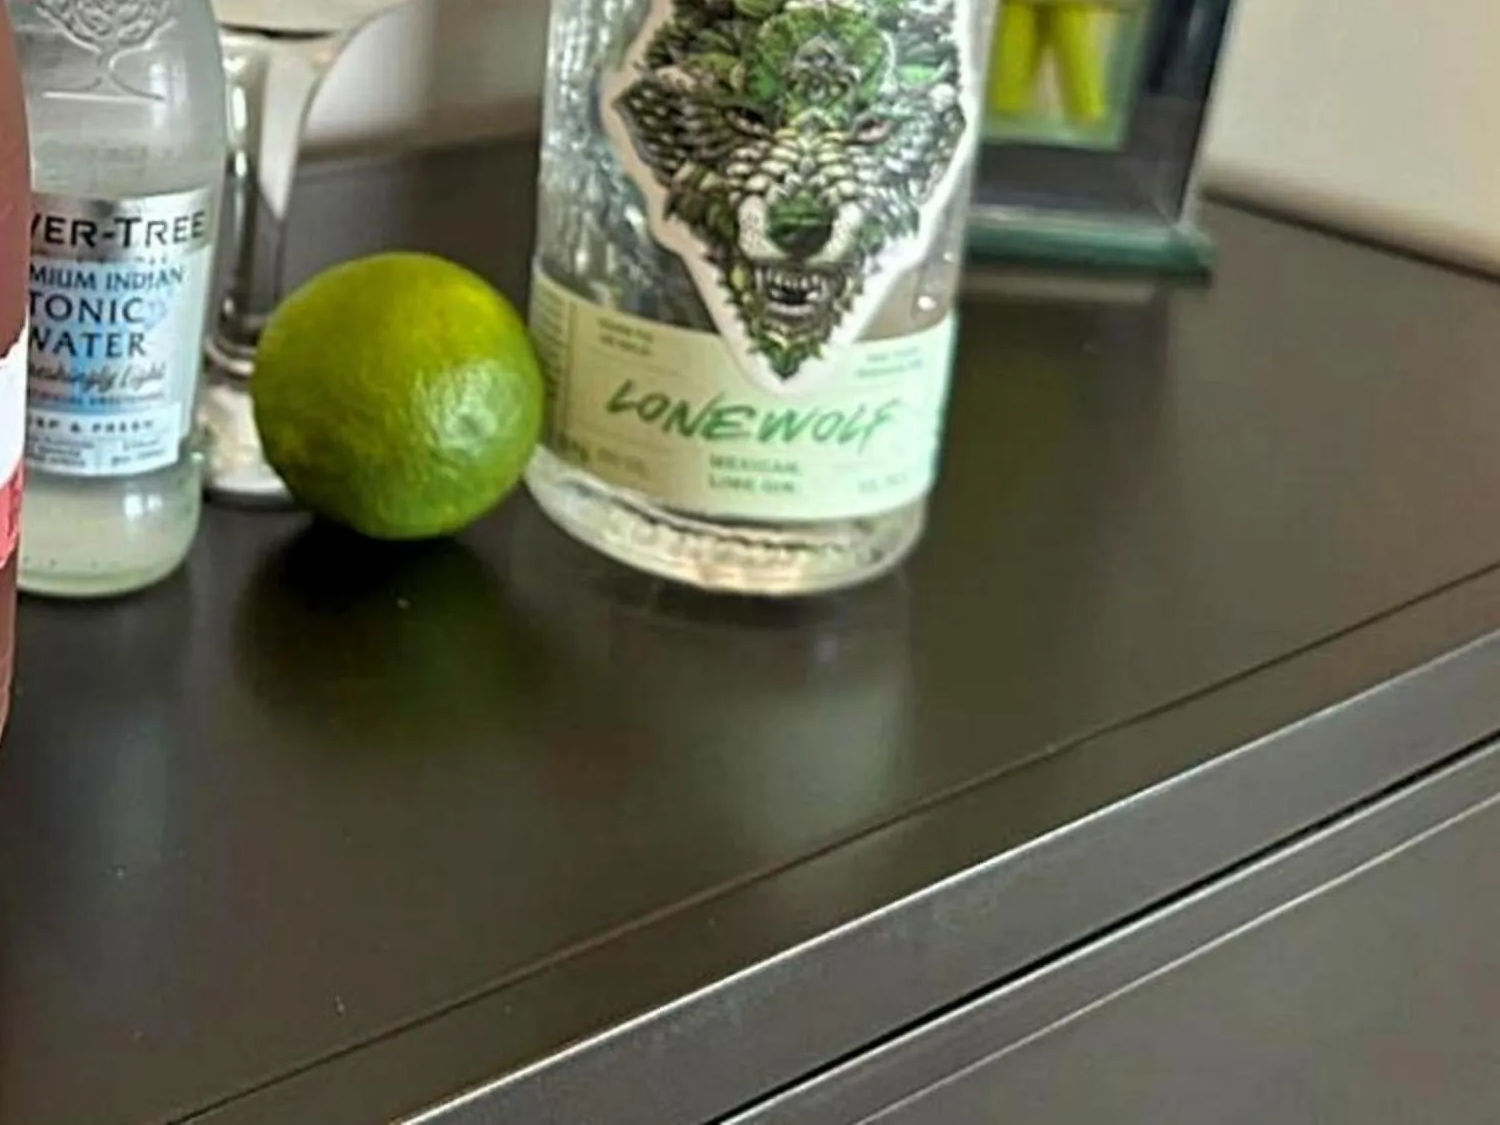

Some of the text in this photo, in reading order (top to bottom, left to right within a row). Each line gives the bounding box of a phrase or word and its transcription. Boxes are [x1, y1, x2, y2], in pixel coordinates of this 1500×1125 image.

[30, 210, 206, 249] VER-TREE
[30, 262, 185, 293] MIUM INDIAN
[29, 290, 146, 324] TONIC
[606, 379, 903, 456] LONEWOLF
